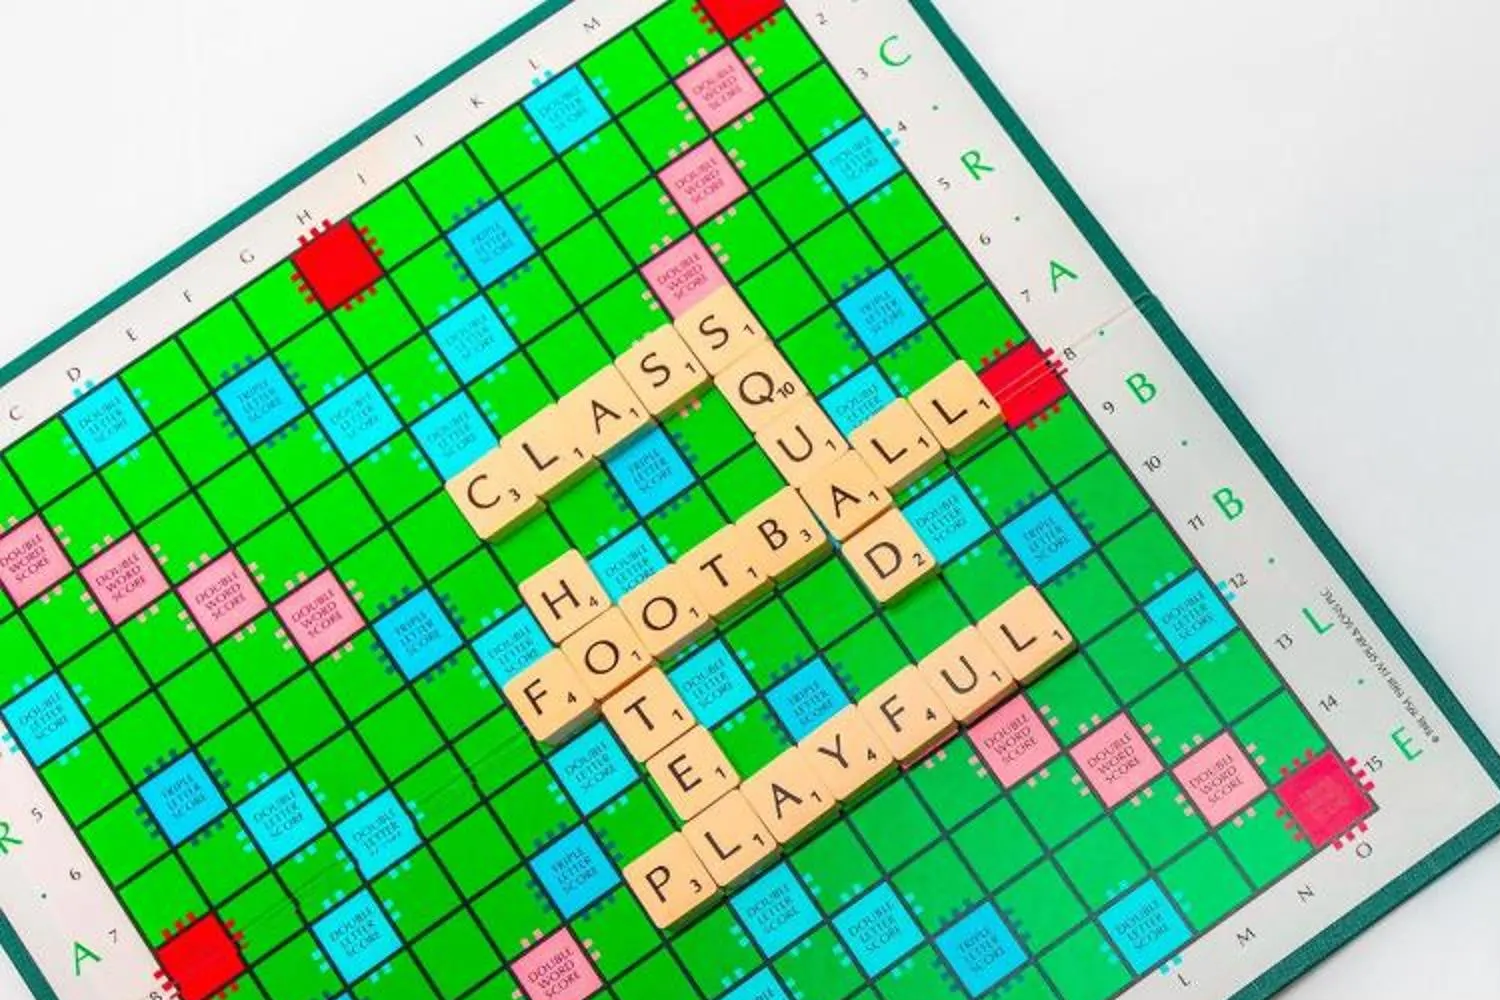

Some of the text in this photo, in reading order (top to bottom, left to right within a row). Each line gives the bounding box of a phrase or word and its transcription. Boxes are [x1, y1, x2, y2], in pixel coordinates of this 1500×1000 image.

[9, 404, 24, 421] C
[64, 365, 81, 383] D
[124, 326, 138, 343] E
[181, 288, 193, 303] F
[238, 247, 255, 265] G
[295, 207, 313, 226] H
[581, 15, 601, 33] M
[466, 313, 729, 509] CLASS
[698, 313, 901, 579] SQUAD
[877, 33, 912, 68] C
[958, 148, 995, 182] R
[1047, 258, 1080, 294] A
[1123, 371, 1158, 405] B
[1210, 486, 1245, 522] B
[1300, 606, 1335, 636] L
[1388, 725, 1424, 762] E
[896, 119, 908, 133] 4
[935, 176, 951, 191] 5
[977, 232, 992, 246] 6
[1018, 287, 1031, 303] 7
[1061, 345, 1078, 361] 8
[1100, 399, 1115, 415] 9
[1141, 454, 1162, 473] 10
[1186, 512, 1206, 531] 11
[1226, 571, 1249, 590] 12
[1272, 632, 1294, 651] 13
[1316, 693, 1339, 713] 14
[1362, 754, 1383, 773] 15
[522, 398, 968, 715] FOOTBALL
[540, 578, 741, 861] HOTEL
[644, 623, 1036, 903] PLAYFUL
[29, 806, 44, 823] 5
[67, 866, 82, 881] 6
[106, 927, 118, 944] 7
[72, 940, 103, 977] A
[1176, 972, 1191, 987] L
[1234, 926, 1257, 948] M
[1295, 883, 1315, 903] N
[1354, 839, 1373, 859] O
